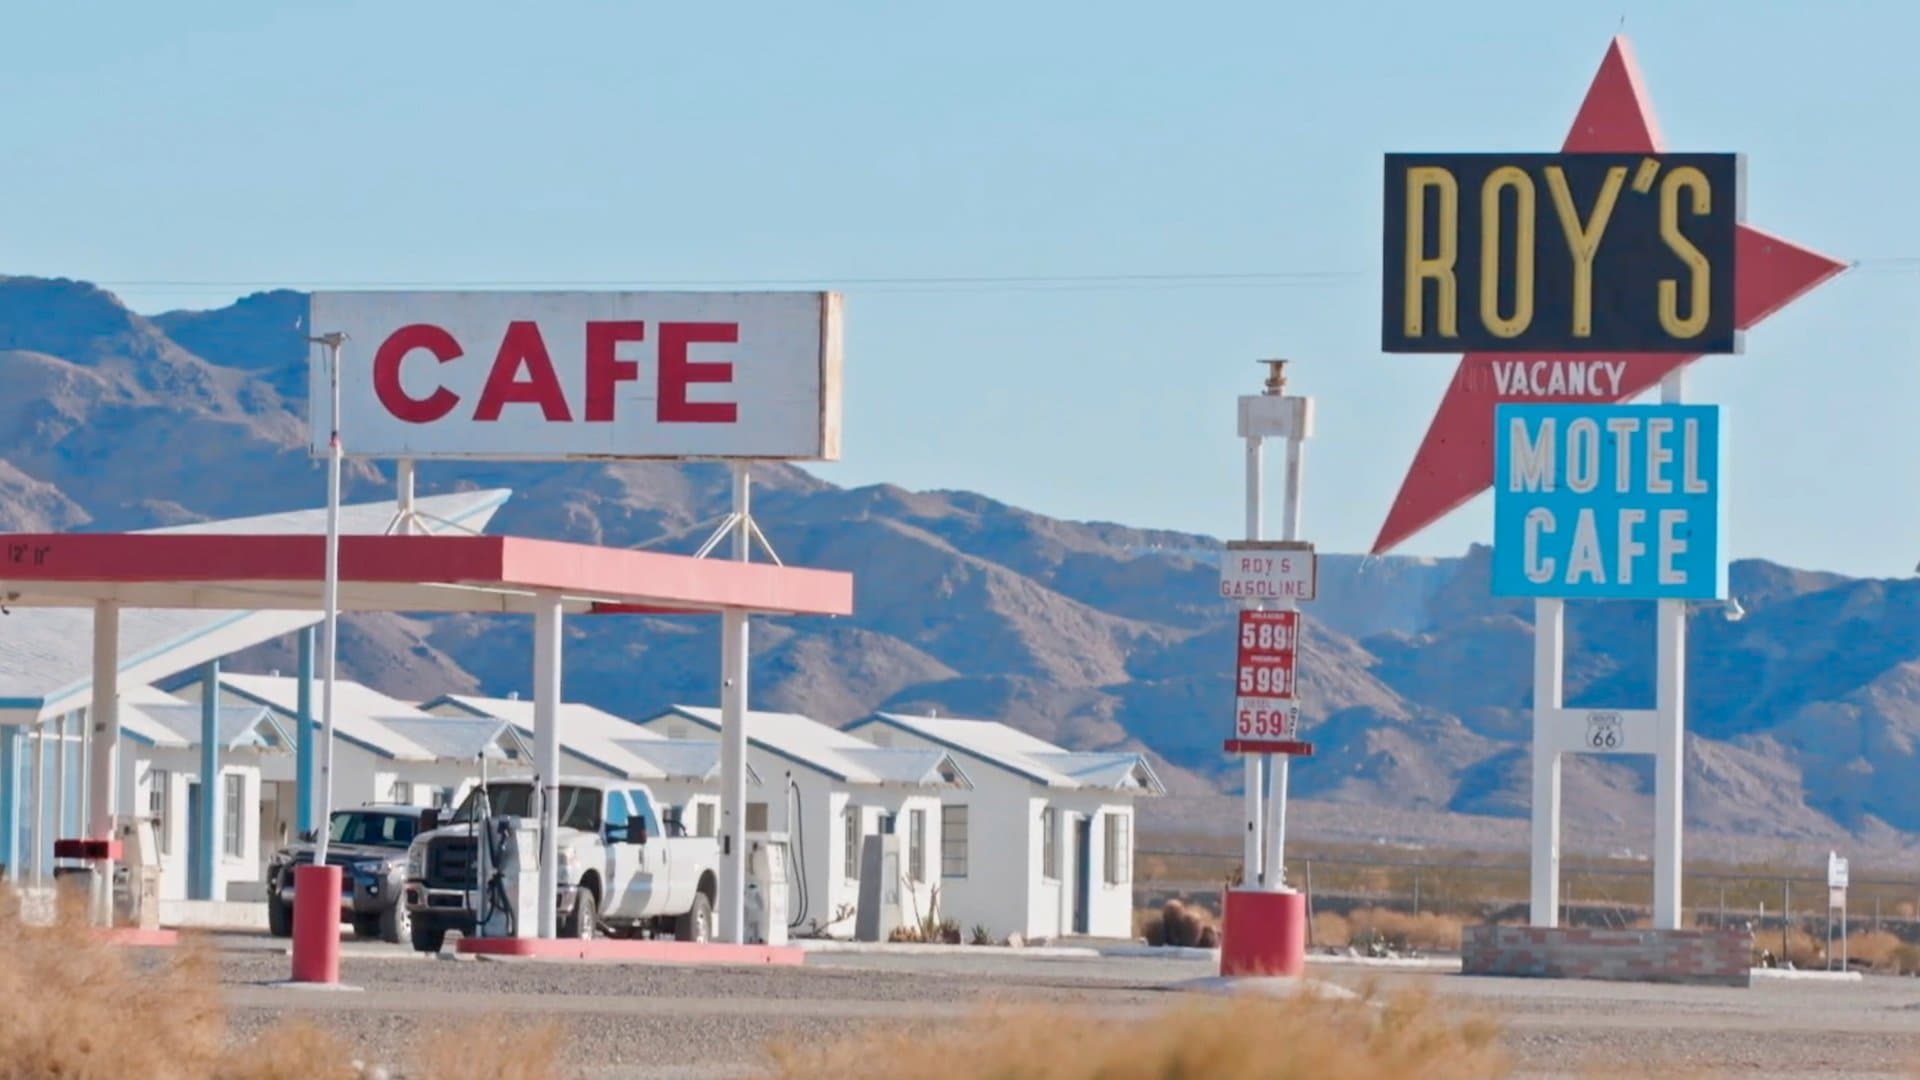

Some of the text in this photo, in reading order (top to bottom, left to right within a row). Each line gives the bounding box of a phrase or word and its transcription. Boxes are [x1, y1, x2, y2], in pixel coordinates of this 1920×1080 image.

[1403, 157, 1712, 338] ROY'S
[373, 320, 738, 424] CAFE
[1492, 360, 1627, 396] VACANCY
[1509, 417, 1708, 493] MOTEL
[1524, 507, 1688, 584] CAFE
[1222, 580, 1306, 596] GASOLINE
[1593, 731, 1616, 747] 66
